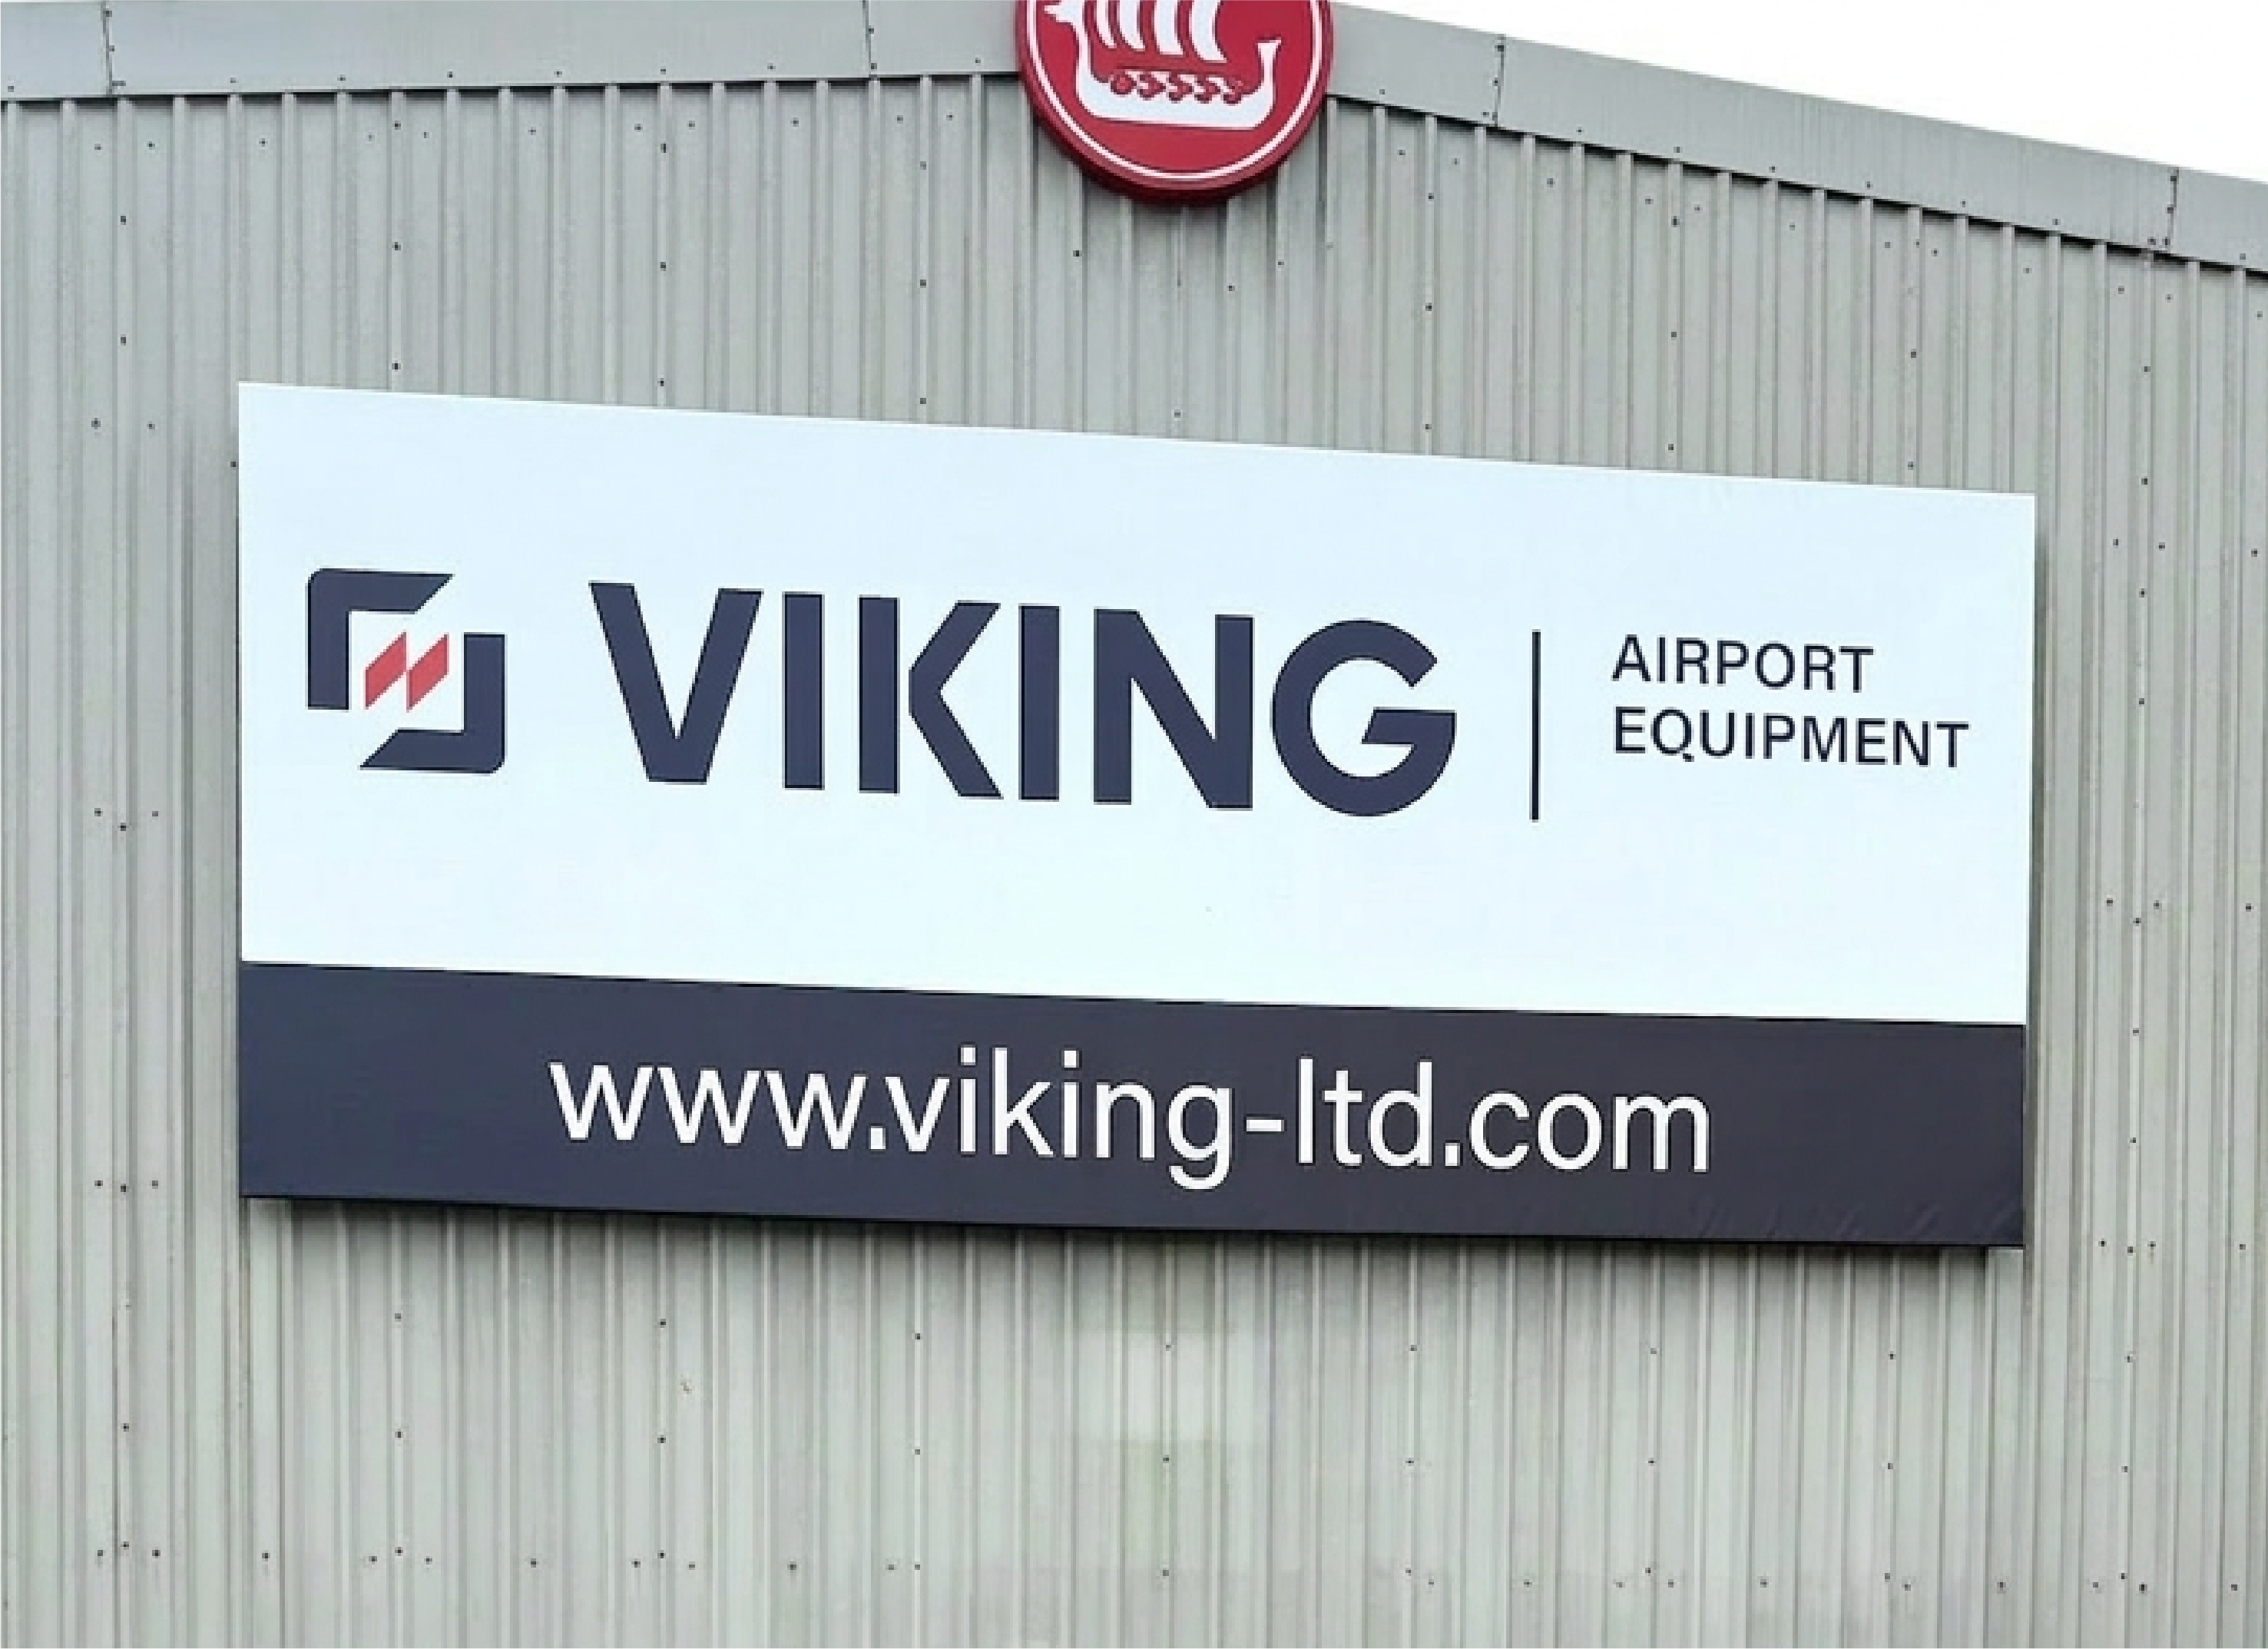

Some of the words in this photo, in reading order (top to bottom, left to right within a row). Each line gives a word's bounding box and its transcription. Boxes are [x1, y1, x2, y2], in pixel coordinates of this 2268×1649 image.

[588, 581, 1458, 817] VIKING
[1612, 634, 1875, 694] AIRPORT
[1614, 705, 1970, 769] EQUIPMENT
[549, 1046, 1712, 1190] www.viking-ltd.com
